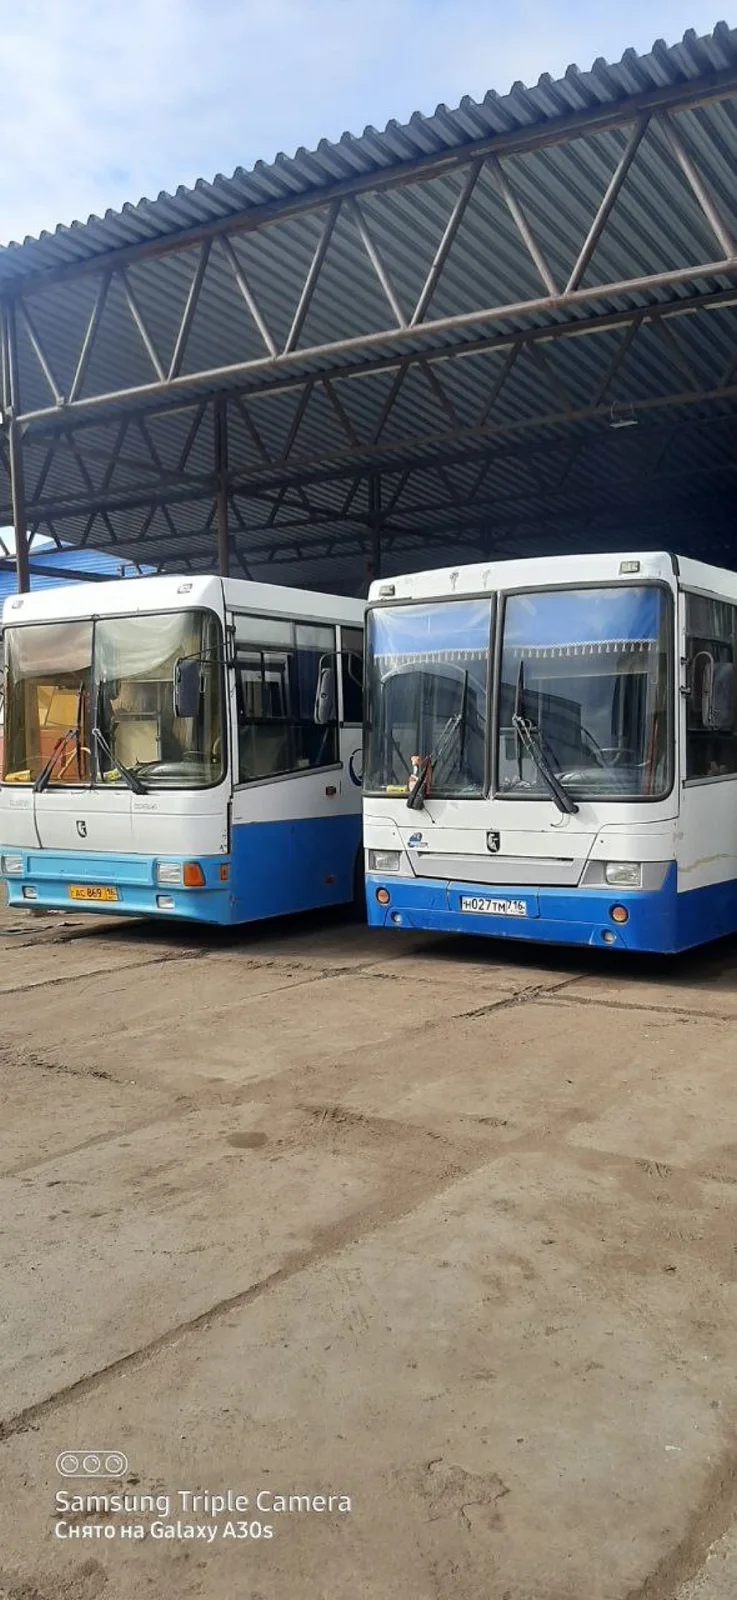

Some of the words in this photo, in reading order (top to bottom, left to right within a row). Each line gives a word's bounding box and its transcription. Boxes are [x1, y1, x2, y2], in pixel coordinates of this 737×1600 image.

[86, 887, 102, 898] 869
[464, 898, 506, 912] Н027ТМ
[507, 900, 524, 911] 716
